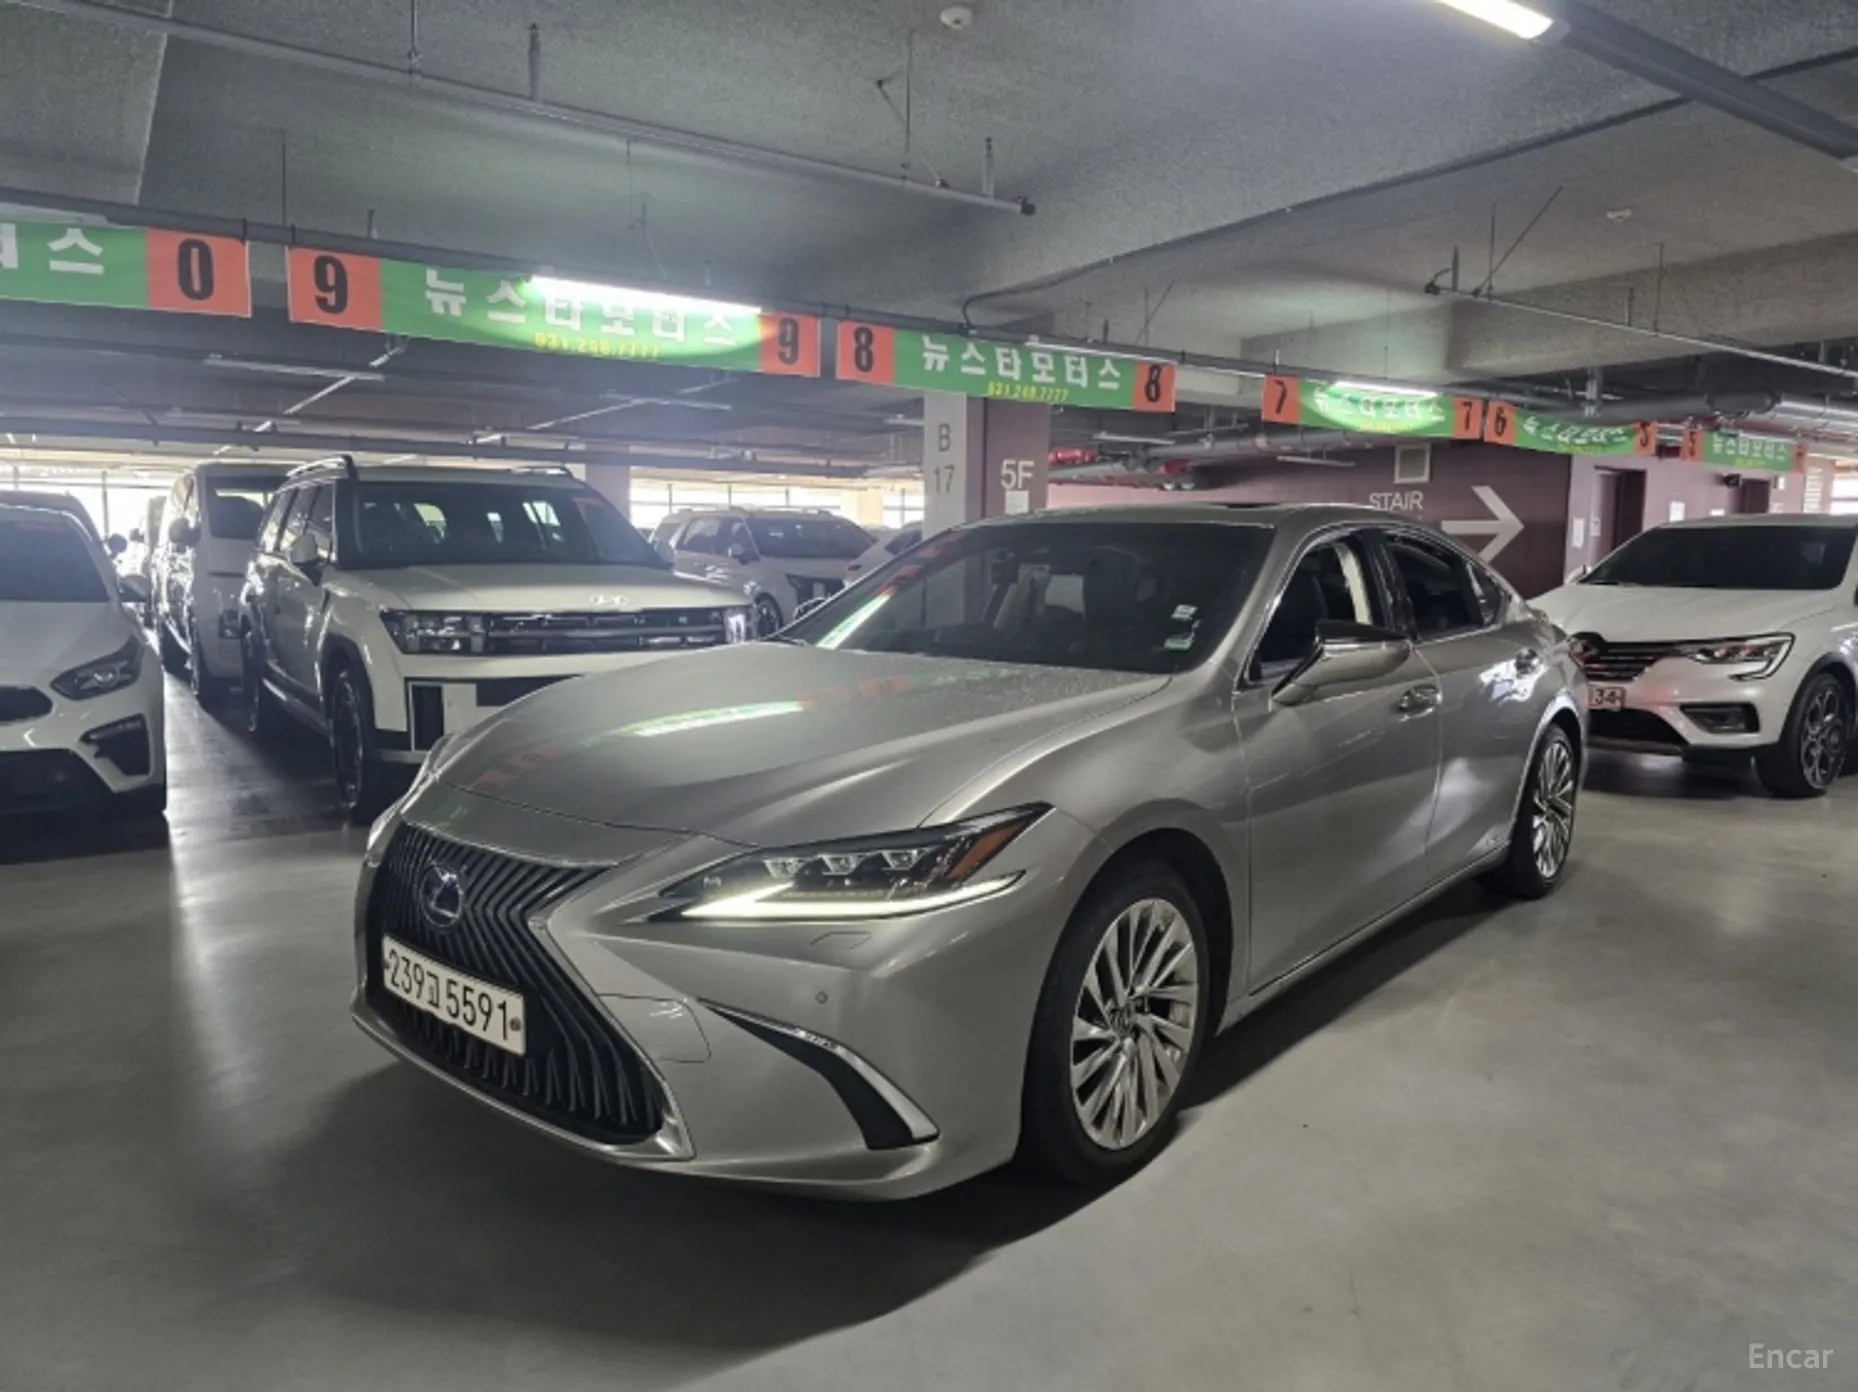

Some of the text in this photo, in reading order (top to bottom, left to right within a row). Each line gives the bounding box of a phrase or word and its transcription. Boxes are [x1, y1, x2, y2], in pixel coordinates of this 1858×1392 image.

[177, 238, 214, 301] 0
[314, 255, 348, 314] 9
[777, 317, 799, 366] 9
[854, 326, 1162, 402] 8 뉴스타모터스 8
[1274, 379, 1287, 414] 7
[1461, 401, 1473, 431] 7
[1494, 405, 1507, 437] 6
[938, 423, 950, 451] B
[933, 465, 955, 493] 17
[1000, 458, 1035, 489] 5F
[1369, 490, 1424, 511] STAIR
